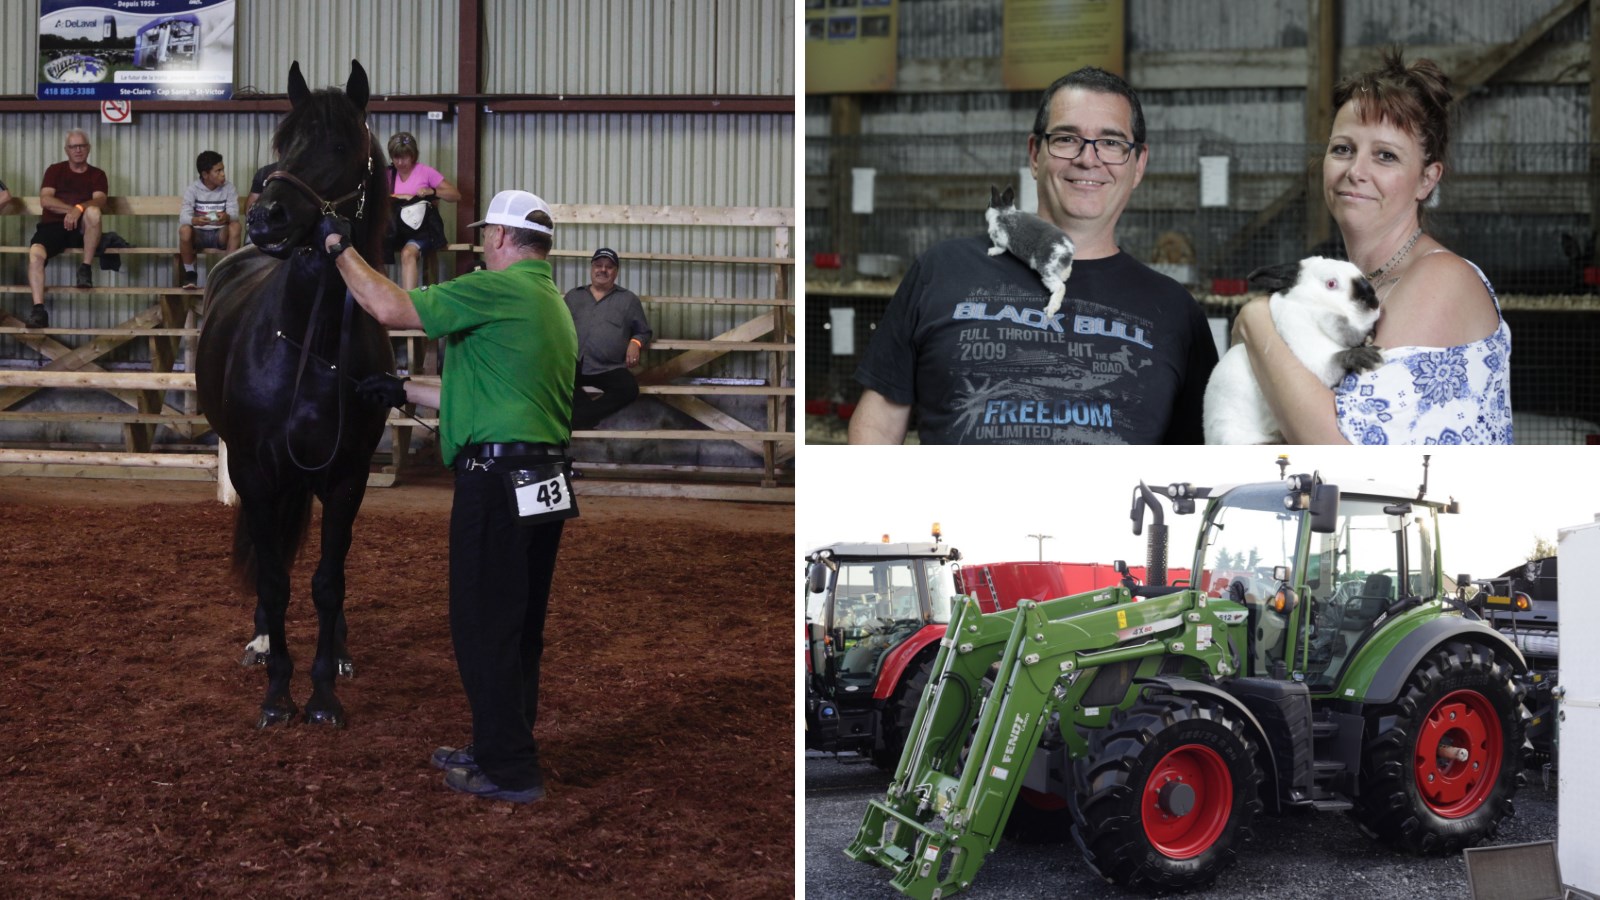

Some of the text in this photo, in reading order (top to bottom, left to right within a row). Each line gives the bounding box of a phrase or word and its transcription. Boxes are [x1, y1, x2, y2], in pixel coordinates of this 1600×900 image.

[65, 19, 97, 28] DeLaval
[44, 88, 58, 96] 418
[157, 88, 169, 97] Cap
[952, 301, 1065, 333] BLACK
[1073, 315, 1154, 349] BULL
[959, 327, 1066, 344] FULL THROTTLE
[960, 342, 1007, 361] 2009
[1068, 342, 1095, 358] HIT
[1095, 353, 1109, 361] THE
[1092, 361, 1123, 374] ROAD
[984, 400, 1113, 428] FREEDOM
[976, 425, 1051, 440] UNLIMITED
[536, 480, 562, 507] 43
[1002, 712, 1024, 763] FENDT
